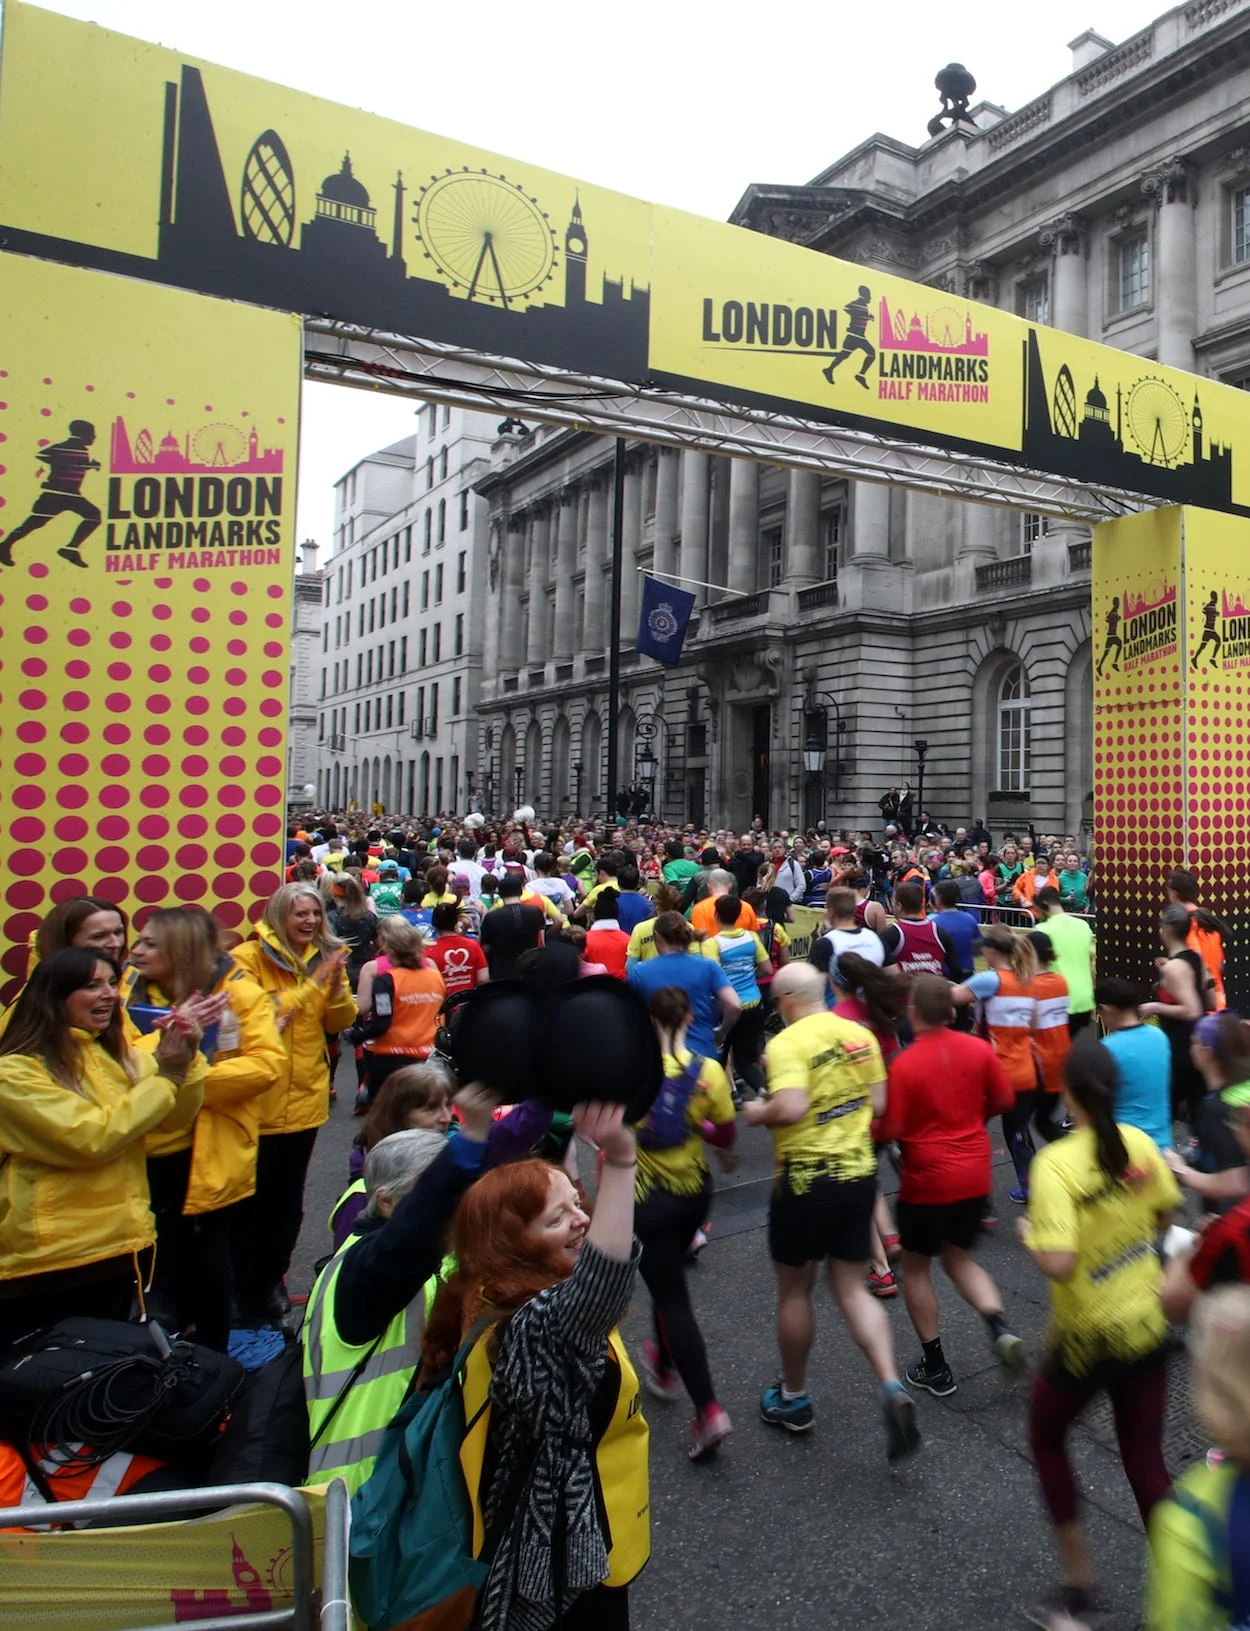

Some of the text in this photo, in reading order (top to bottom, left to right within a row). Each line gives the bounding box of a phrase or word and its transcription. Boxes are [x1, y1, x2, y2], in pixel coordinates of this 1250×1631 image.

[702, 298, 838, 350] LONDON
[878, 352, 989, 382] LANDMARKS
[878, 380, 989, 403] HALF MARATHON
[107, 477, 283, 519] LONDON
[106, 520, 281, 551] LANDMARKS
[105, 548, 281, 573] HALF MARATHON
[1123, 602, 1176, 644] LONDON
[1123, 627, 1177, 661] LANDMARKS
[1124, 644, 1177, 672] HALF MARATHON
[1223, 660, 1238, 670] HALF
